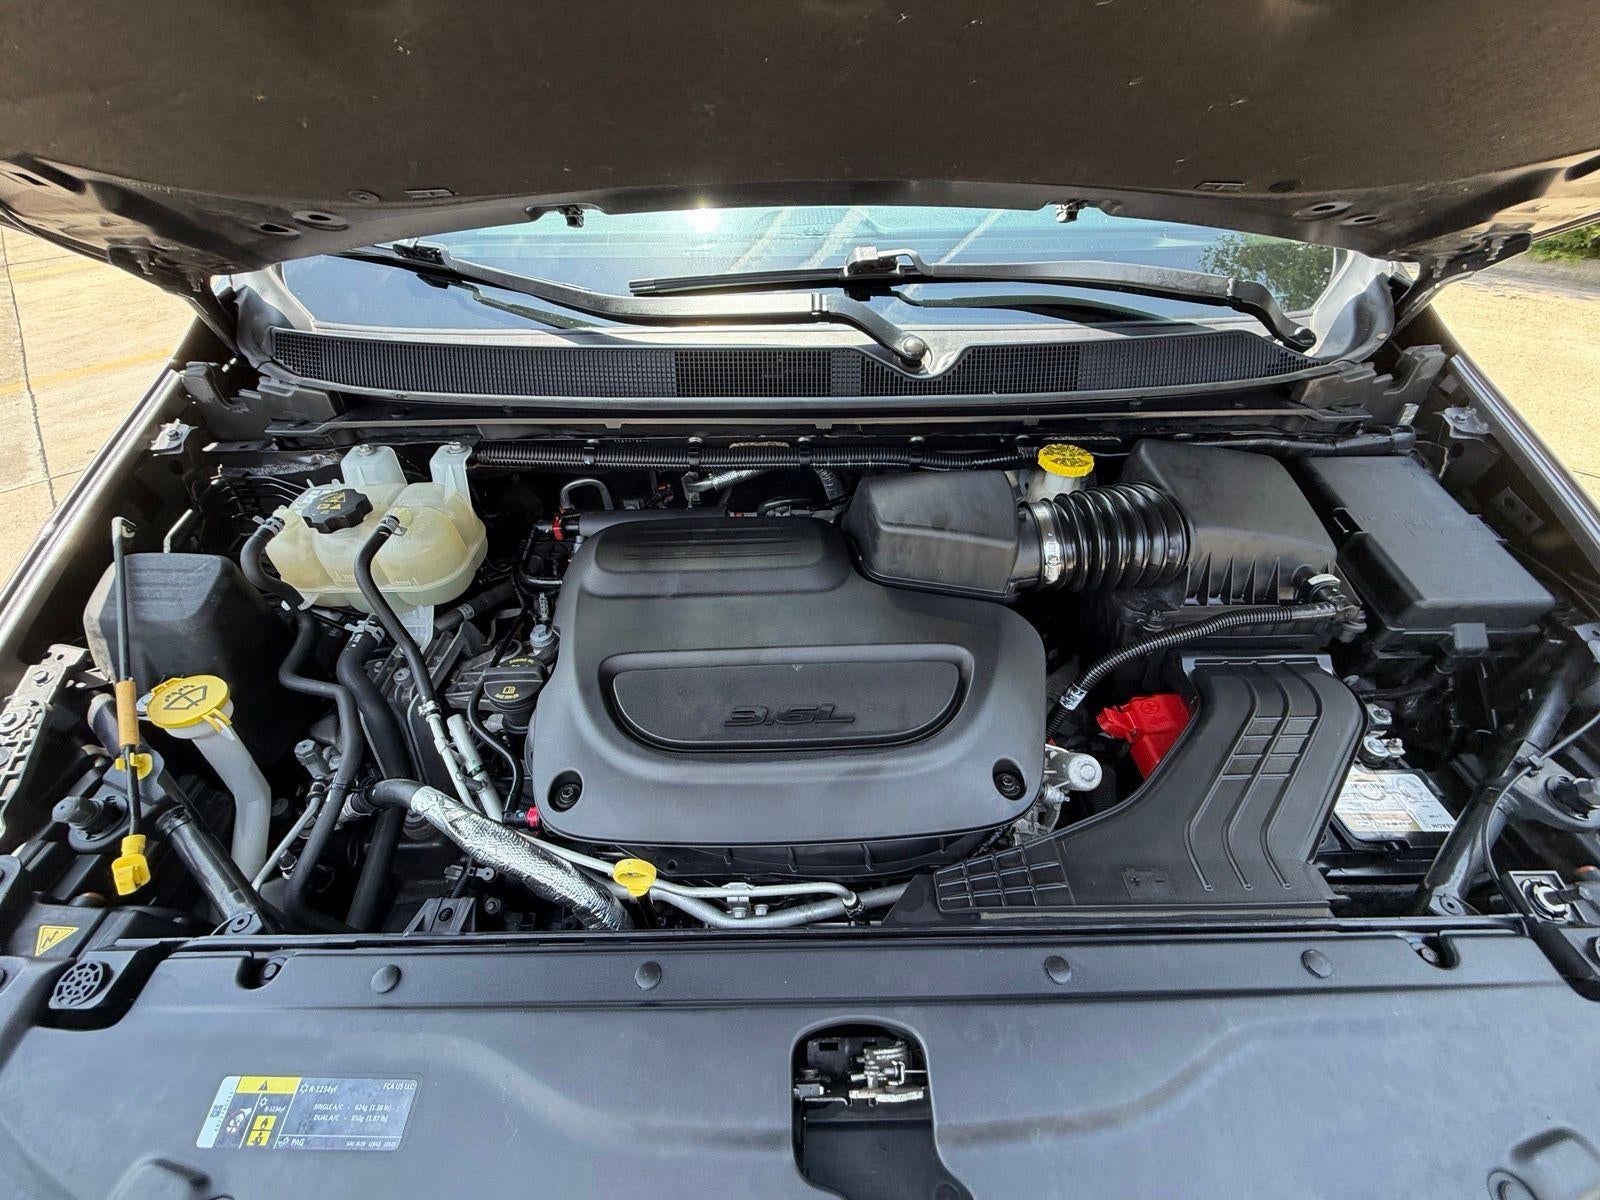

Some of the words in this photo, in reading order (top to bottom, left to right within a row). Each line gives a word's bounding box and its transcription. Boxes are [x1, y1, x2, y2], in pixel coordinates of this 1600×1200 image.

[723, 703, 856, 728] 3.6L
[308, 1085, 339, 1094] R-1234yf
[384, 1082, 394, 1090] FCA
[313, 1103, 332, 1111] SINGLE
[291, 1139, 305, 1147] PAG
